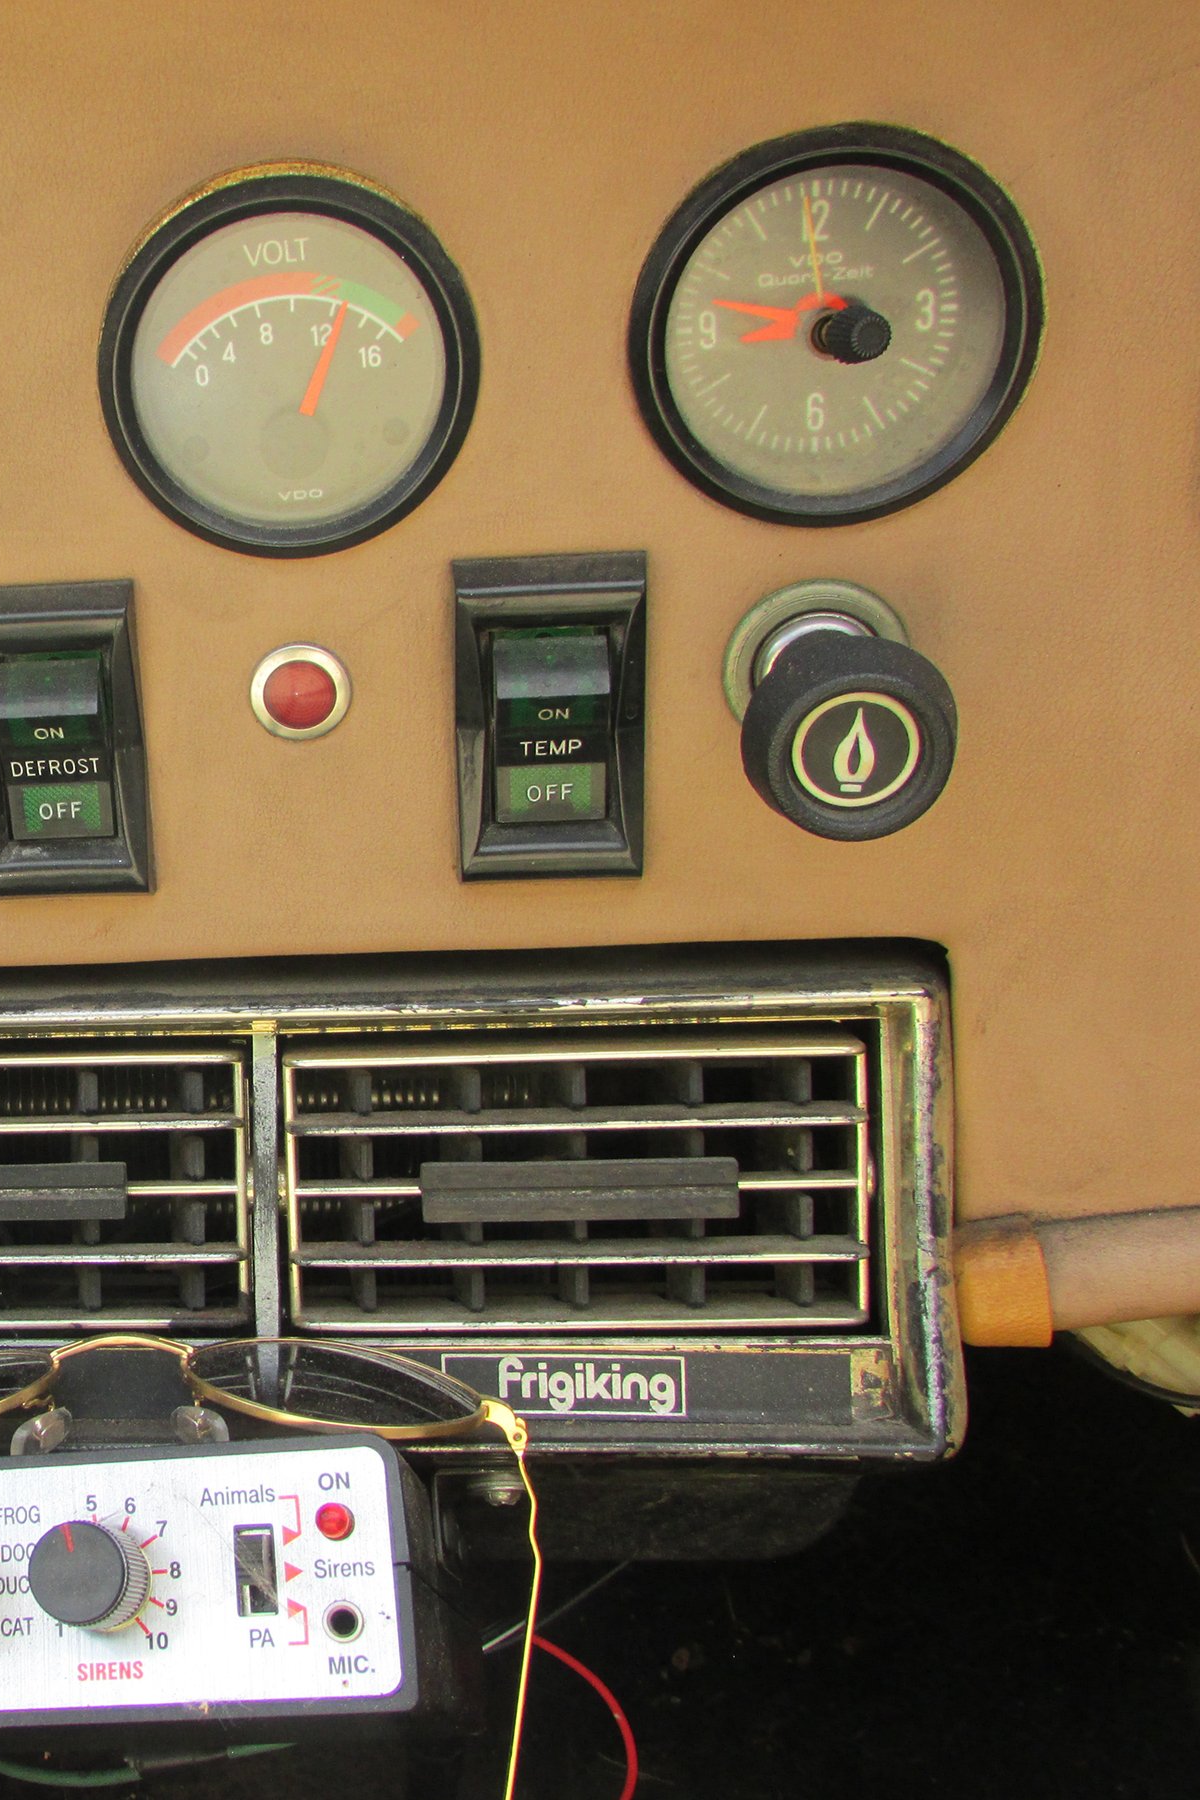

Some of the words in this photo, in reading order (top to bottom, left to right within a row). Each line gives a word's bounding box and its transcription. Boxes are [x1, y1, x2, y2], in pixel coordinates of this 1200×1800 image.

[801, 199, 830, 242] 12
[243, 237, 309, 267] VOLT
[914, 288, 936, 332] 3
[259, 322, 274, 346] 8
[310, 323, 333, 348] 12
[699, 310, 717, 350] 9
[221, 341, 237, 364] 4
[357, 345, 383, 369] 16
[195, 364, 210, 387] 0
[805, 392, 825, 432] 6
[277, 488, 324, 501] VDO
[538, 708, 570, 721] ON
[34, 727, 65, 740] ON
[520, 739, 583, 757] TEMP
[10, 757, 100, 778] DEFROST
[527, 783, 574, 803] OFF
[39, 801, 83, 821] OFF
[498, 1356, 676, 1414] frigiking
[317, 1472, 351, 1491] ON
[86, 1495, 97, 1512] 5
[124, 1497, 137, 1515] 6
[200, 1484, 276, 1508] Animals
[156, 1519, 168, 1537] 7
[169, 1561, 181, 1579] 8
[314, 1558, 376, 1580] Sirens
[166, 1599, 178, 1617] 9
[0, 1616, 34, 1637] CAT
[148, 1631, 169, 1651] 10
[250, 1628, 275, 1649] PA
[77, 1660, 144, 1682] SIRENS
[329, 1654, 376, 1676] MIC.
